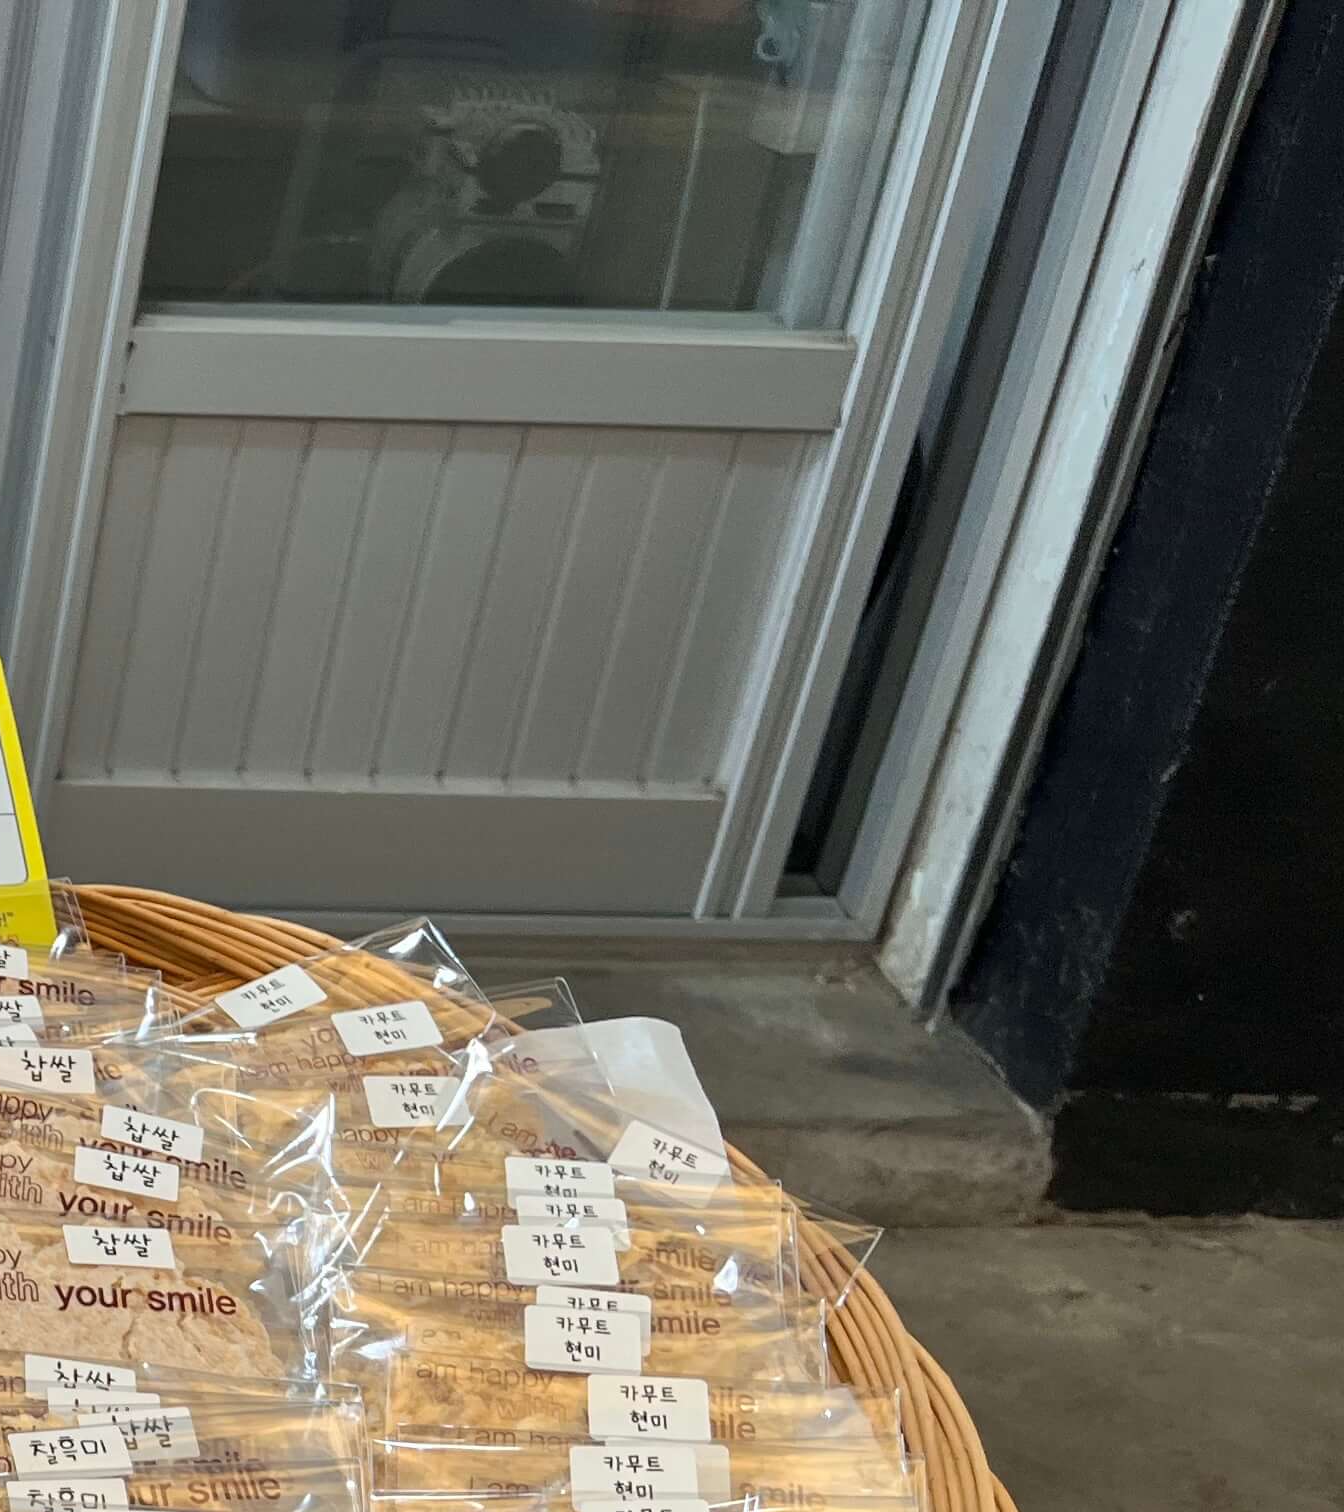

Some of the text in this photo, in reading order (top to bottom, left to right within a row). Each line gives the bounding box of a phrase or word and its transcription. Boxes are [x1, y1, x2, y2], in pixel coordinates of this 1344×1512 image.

[21, 1050, 77, 1082] 찹쌀
[390, 1083, 440, 1099] 카무트
[403, 1102, 435, 1120] 현미
[123, 1116, 180, 1150] 찹쌀
[105, 1155, 161, 1188] 찹쌀
[534, 1165, 587, 1180] 카무트
[58, 1191, 134, 1223] your
[147, 1207, 232, 1245] smile
[92, 1229, 152, 1258] 찹쌀
[531, 1234, 586, 1250] 카무트
[543, 1257, 580, 1276] 현미
[54, 1285, 132, 1312] your
[148, 1286, 237, 1317] smile
[555, 1317, 612, 1335] 카무트
[565, 1340, 602, 1362] 현미
[619, 1385, 678, 1402] 카무트
[630, 1410, 668, 1432] 현미
[29, 1436, 107, 1465] 찰흑미
[603, 1455, 665, 1472] 카무트
[614, 1480, 654, 1500] 현미
